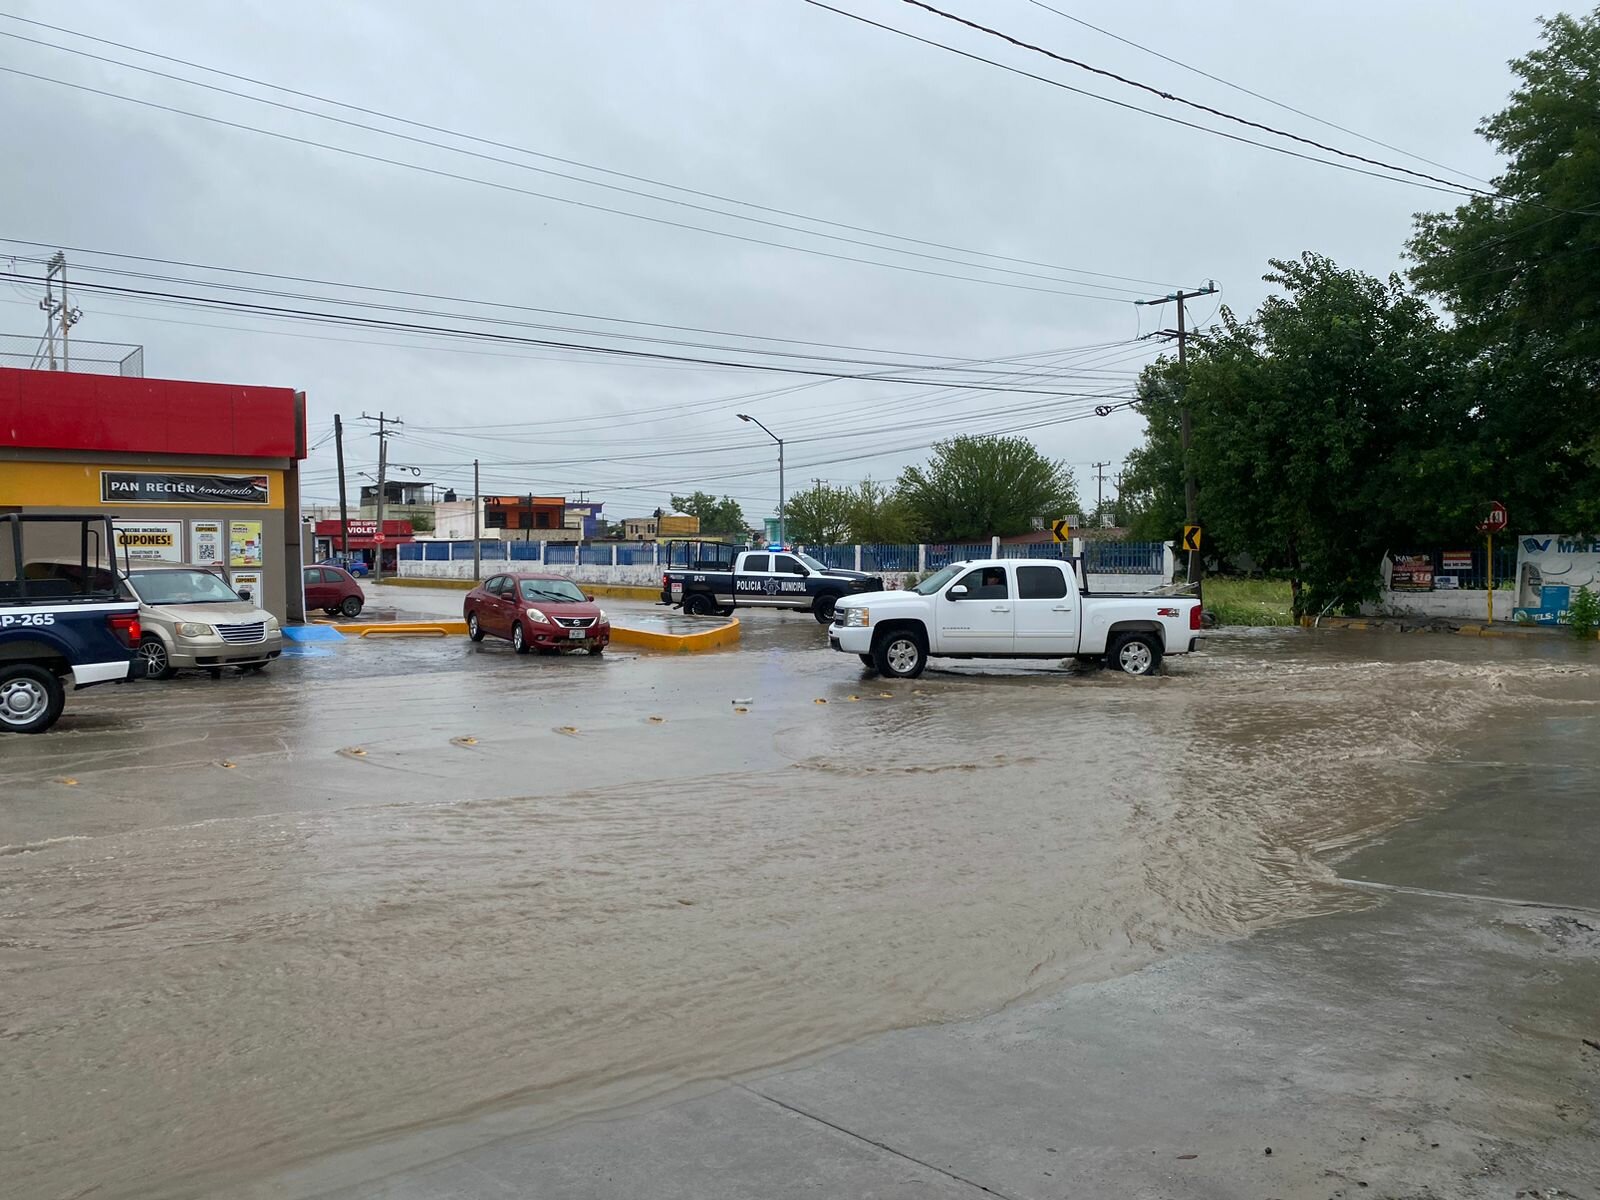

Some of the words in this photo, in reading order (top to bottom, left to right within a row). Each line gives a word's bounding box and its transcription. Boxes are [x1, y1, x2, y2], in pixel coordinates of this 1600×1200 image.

[111, 482, 139, 491] PAN
[146, 481, 195, 493] RECIÉN
[196, 486, 252, 495] horneado
[119, 535, 171, 545] CUPONES!
[736, 580, 761, 591] POLICIA
[781, 581, 807, 592] MUNICIPAL
[0, 613, 55, 627] P-265
